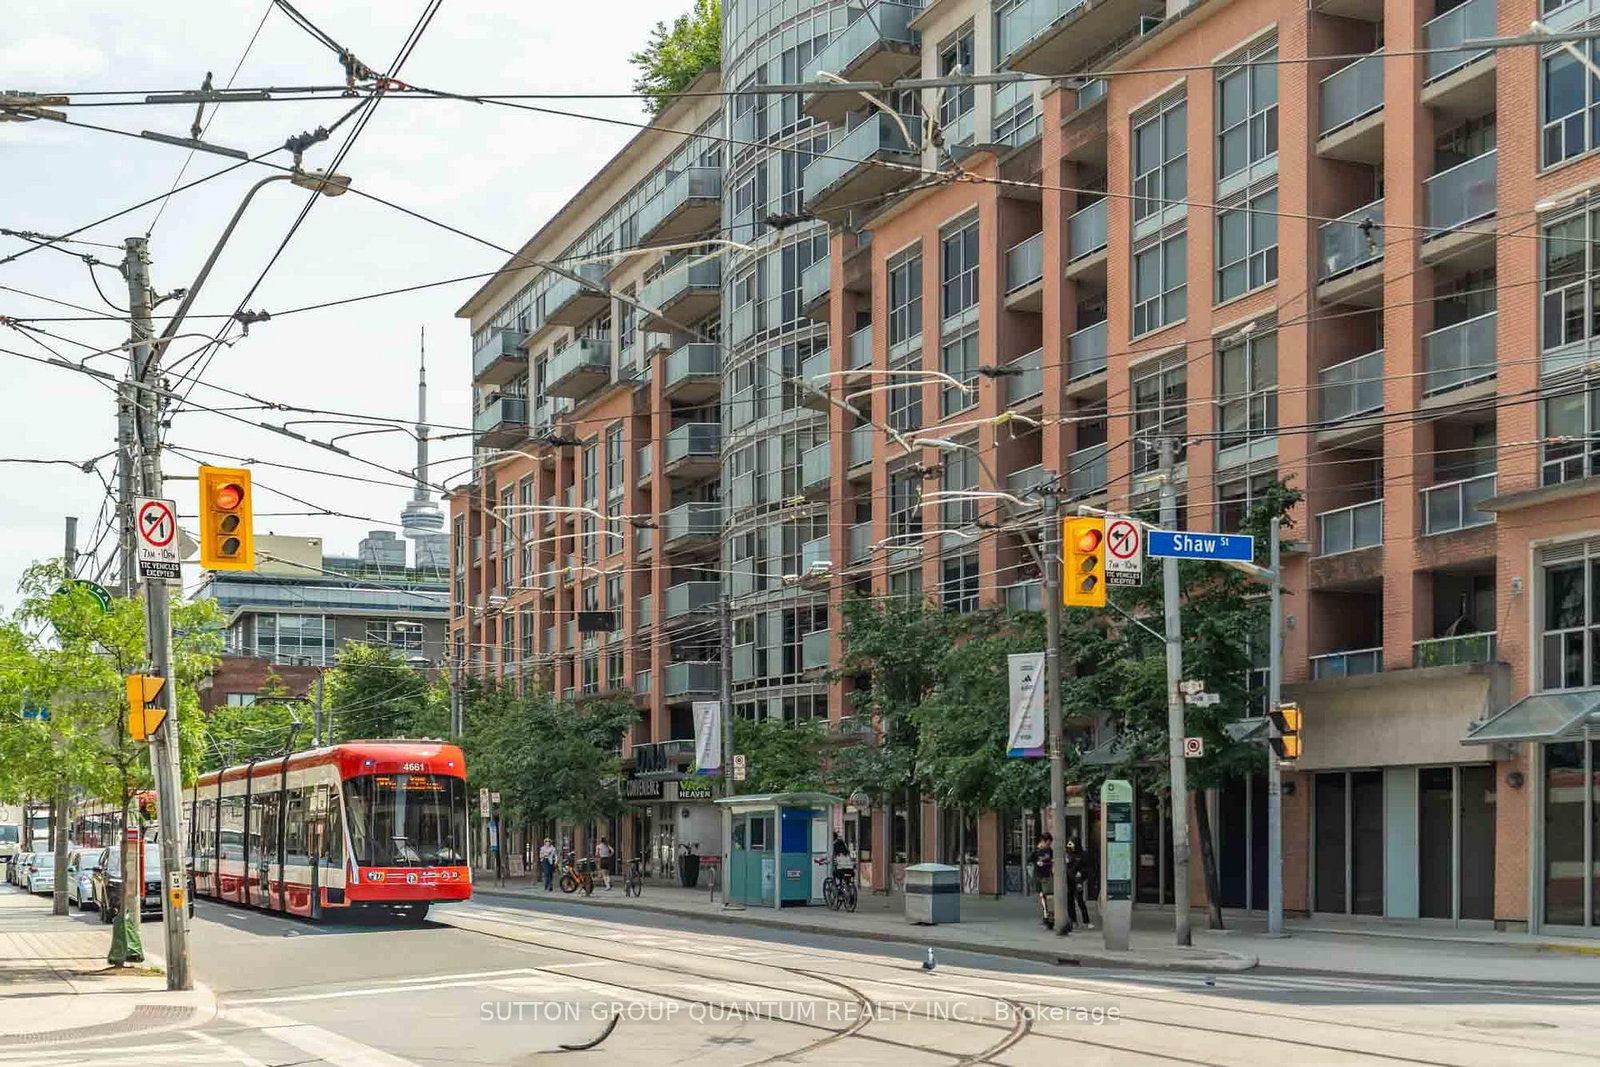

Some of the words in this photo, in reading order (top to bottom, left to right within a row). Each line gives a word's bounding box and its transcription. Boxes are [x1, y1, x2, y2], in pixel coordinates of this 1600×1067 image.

[1173, 535, 1215, 553] Shaw
[1220, 537, 1230, 546] St
[152, 562, 179, 571] VEHICLES
[146, 569, 175, 577] EXCEPTED
[403, 763, 425, 771] 4661
[679, 790, 711, 798] HEAVEN
